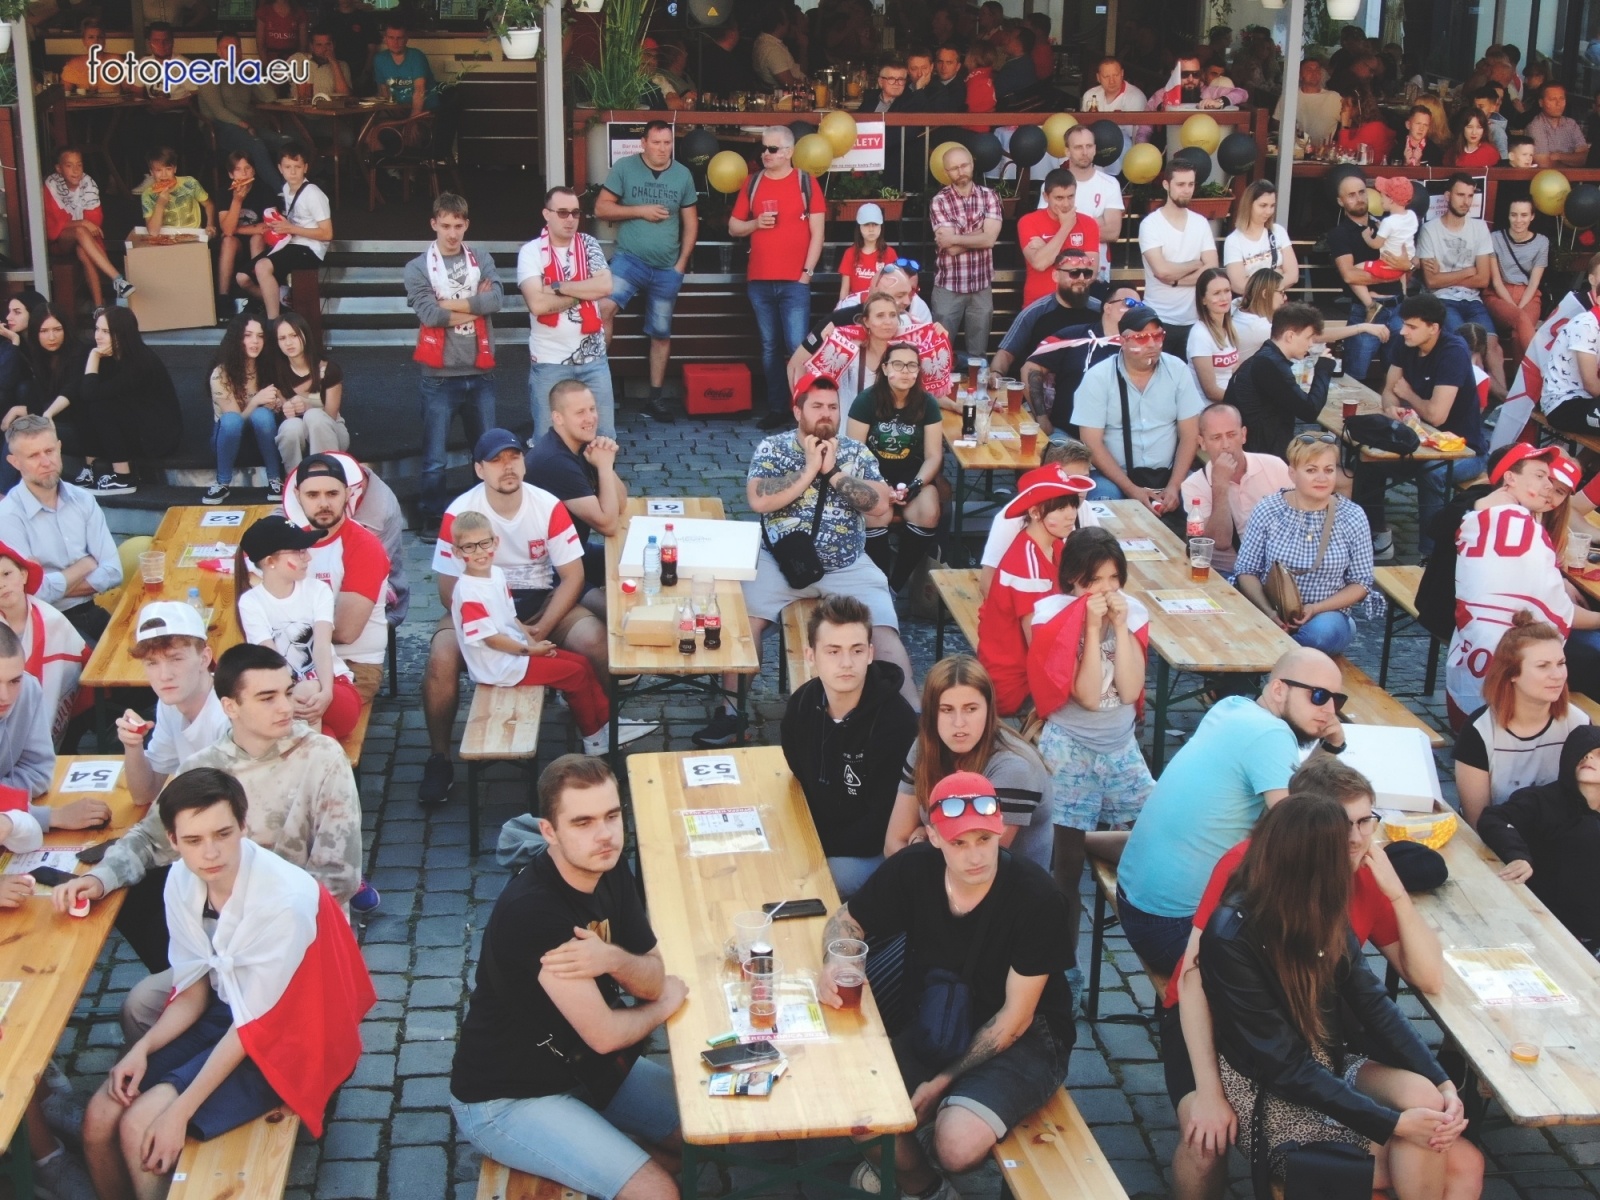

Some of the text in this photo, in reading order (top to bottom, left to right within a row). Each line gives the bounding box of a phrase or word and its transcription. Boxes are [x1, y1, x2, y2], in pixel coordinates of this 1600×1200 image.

[853, 137, 881, 147] LETY
[1094, 193, 1101, 208] 9
[834, 333, 856, 350] YLKO
[925, 378, 950, 390] POLSK
[70, 769, 113, 783] 54
[692, 763, 731, 776] 53
